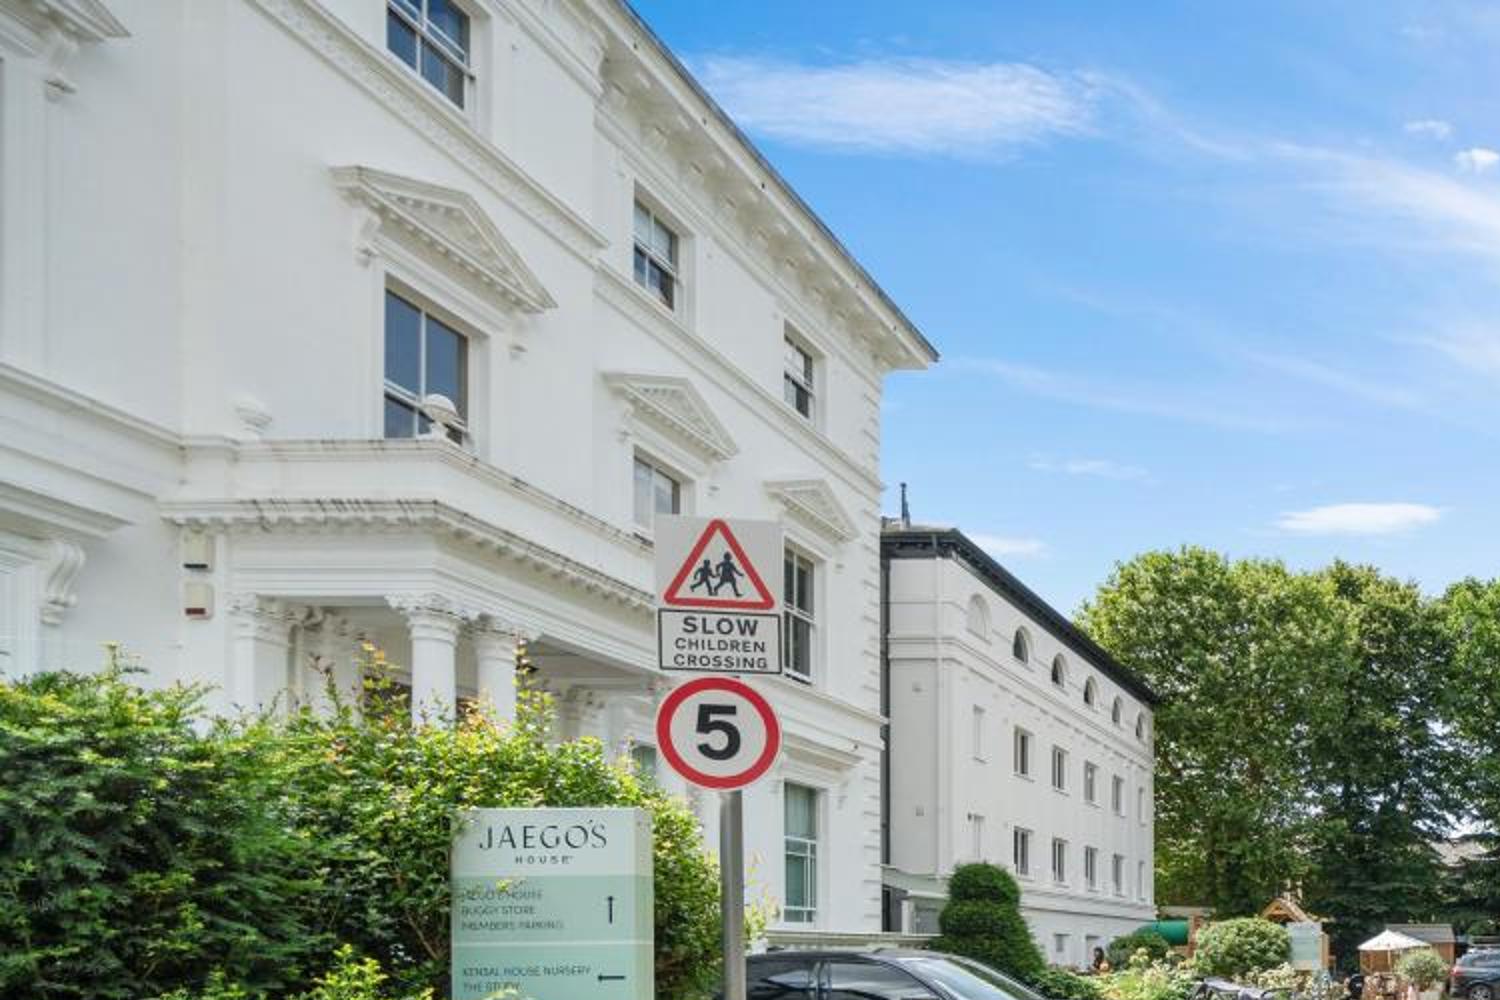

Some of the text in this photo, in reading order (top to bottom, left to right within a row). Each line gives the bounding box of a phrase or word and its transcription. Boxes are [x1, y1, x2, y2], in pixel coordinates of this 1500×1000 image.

[682, 616, 759, 637] SLOW
[674, 637, 766, 653] CHILDREN
[673, 653, 768, 669] CROSSING
[696, 703, 741, 761] 5
[479, 819, 608, 851] JAEGO'S
[515, 855, 572, 865] HOUSE
[543, 965, 592, 976] NURSERY
